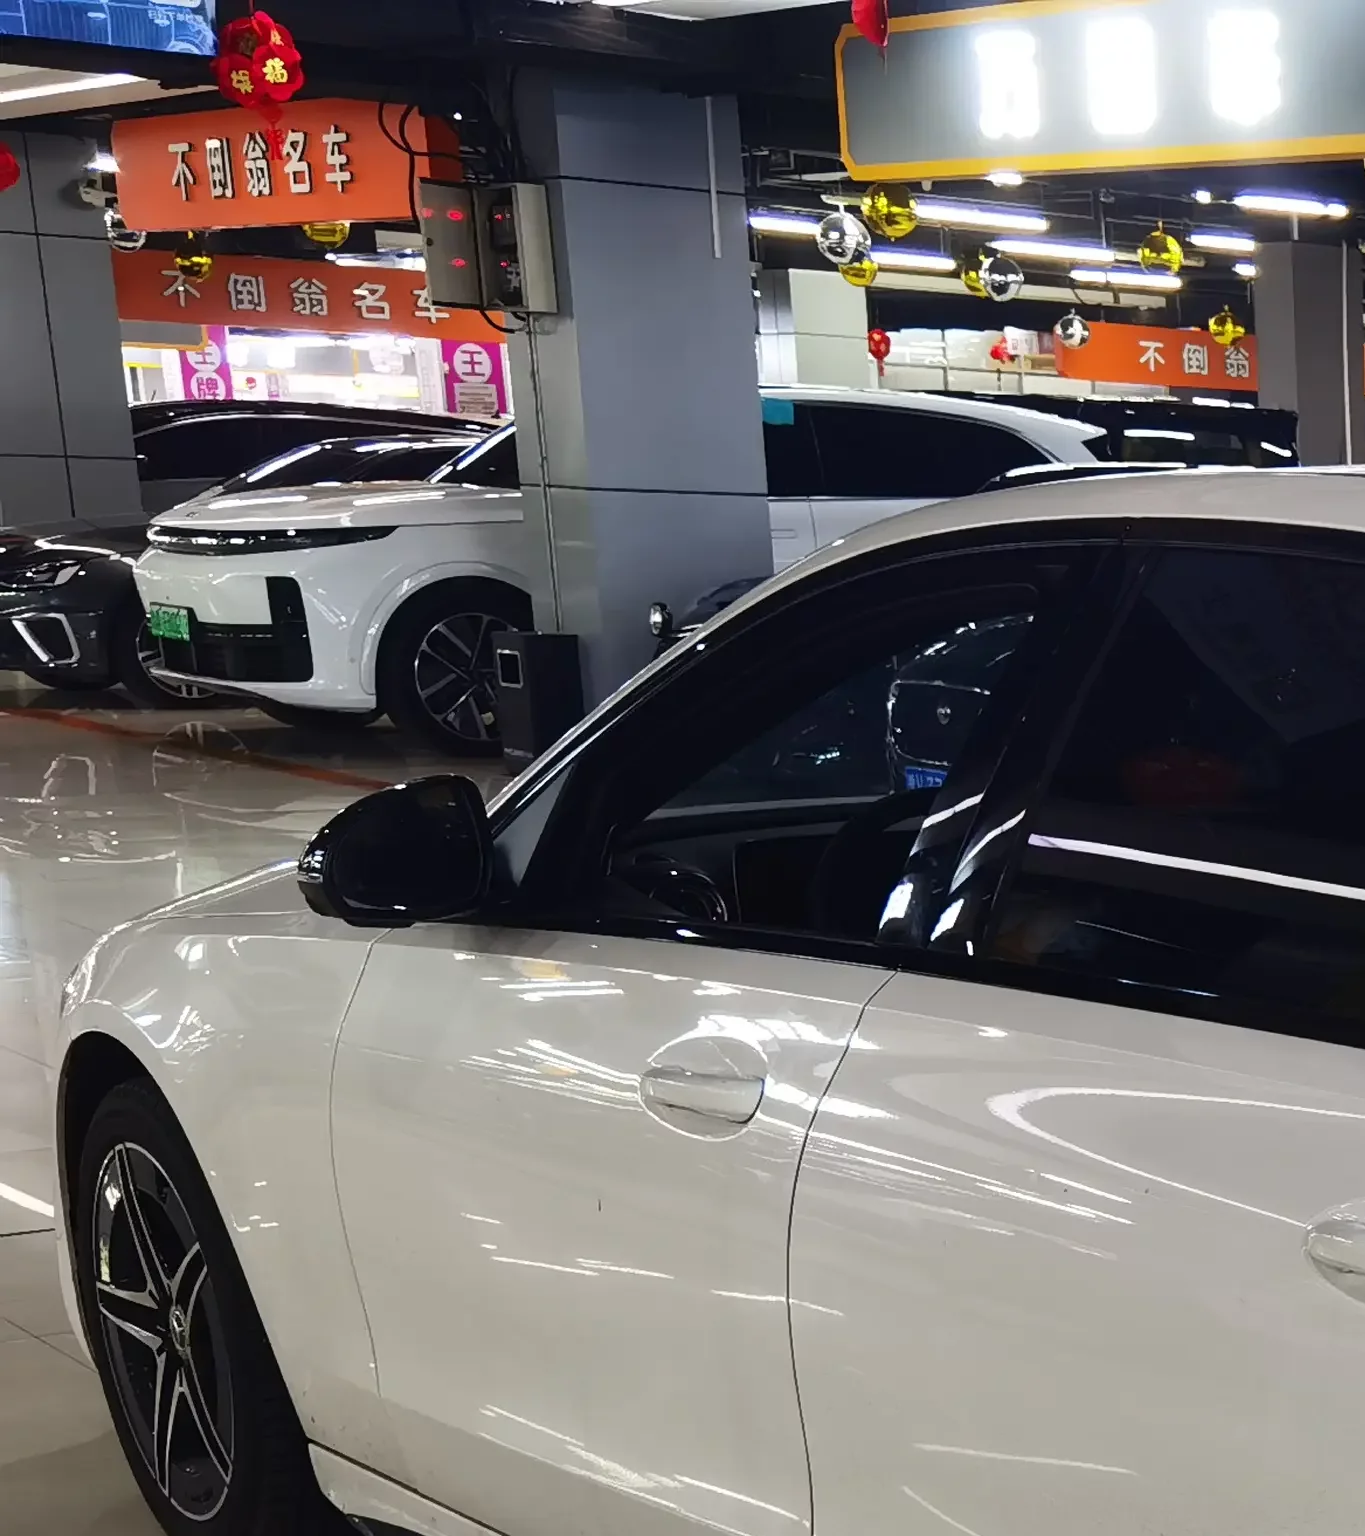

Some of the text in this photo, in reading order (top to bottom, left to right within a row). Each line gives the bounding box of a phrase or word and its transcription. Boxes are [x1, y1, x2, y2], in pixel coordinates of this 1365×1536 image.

[167, 124, 352, 201] 不倒翁名车
[160, 269, 451, 324] 不倒翁名车
[1137, 339, 1251, 379] 不倒翁
